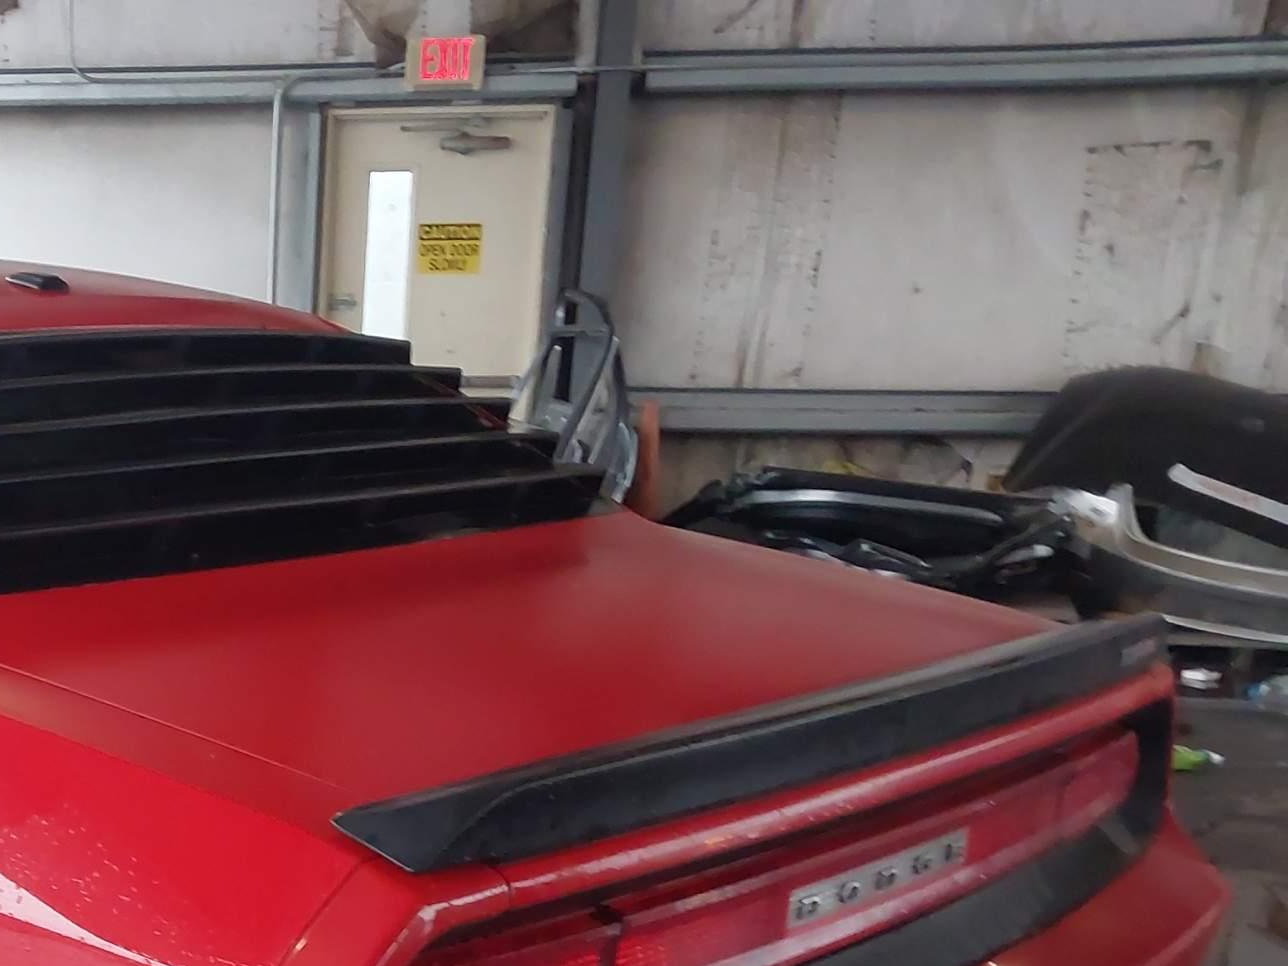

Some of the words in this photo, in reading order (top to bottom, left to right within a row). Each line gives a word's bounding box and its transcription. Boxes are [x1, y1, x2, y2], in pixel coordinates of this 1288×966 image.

[420, 38, 473, 80] EXIT
[421, 225, 480, 239] CAUTION
[420, 243, 446, 256] OPEN
[450, 243, 478, 256] DOOR
[428, 258, 467, 271] SLOWLY
[794, 841, 967, 921] DODGE
